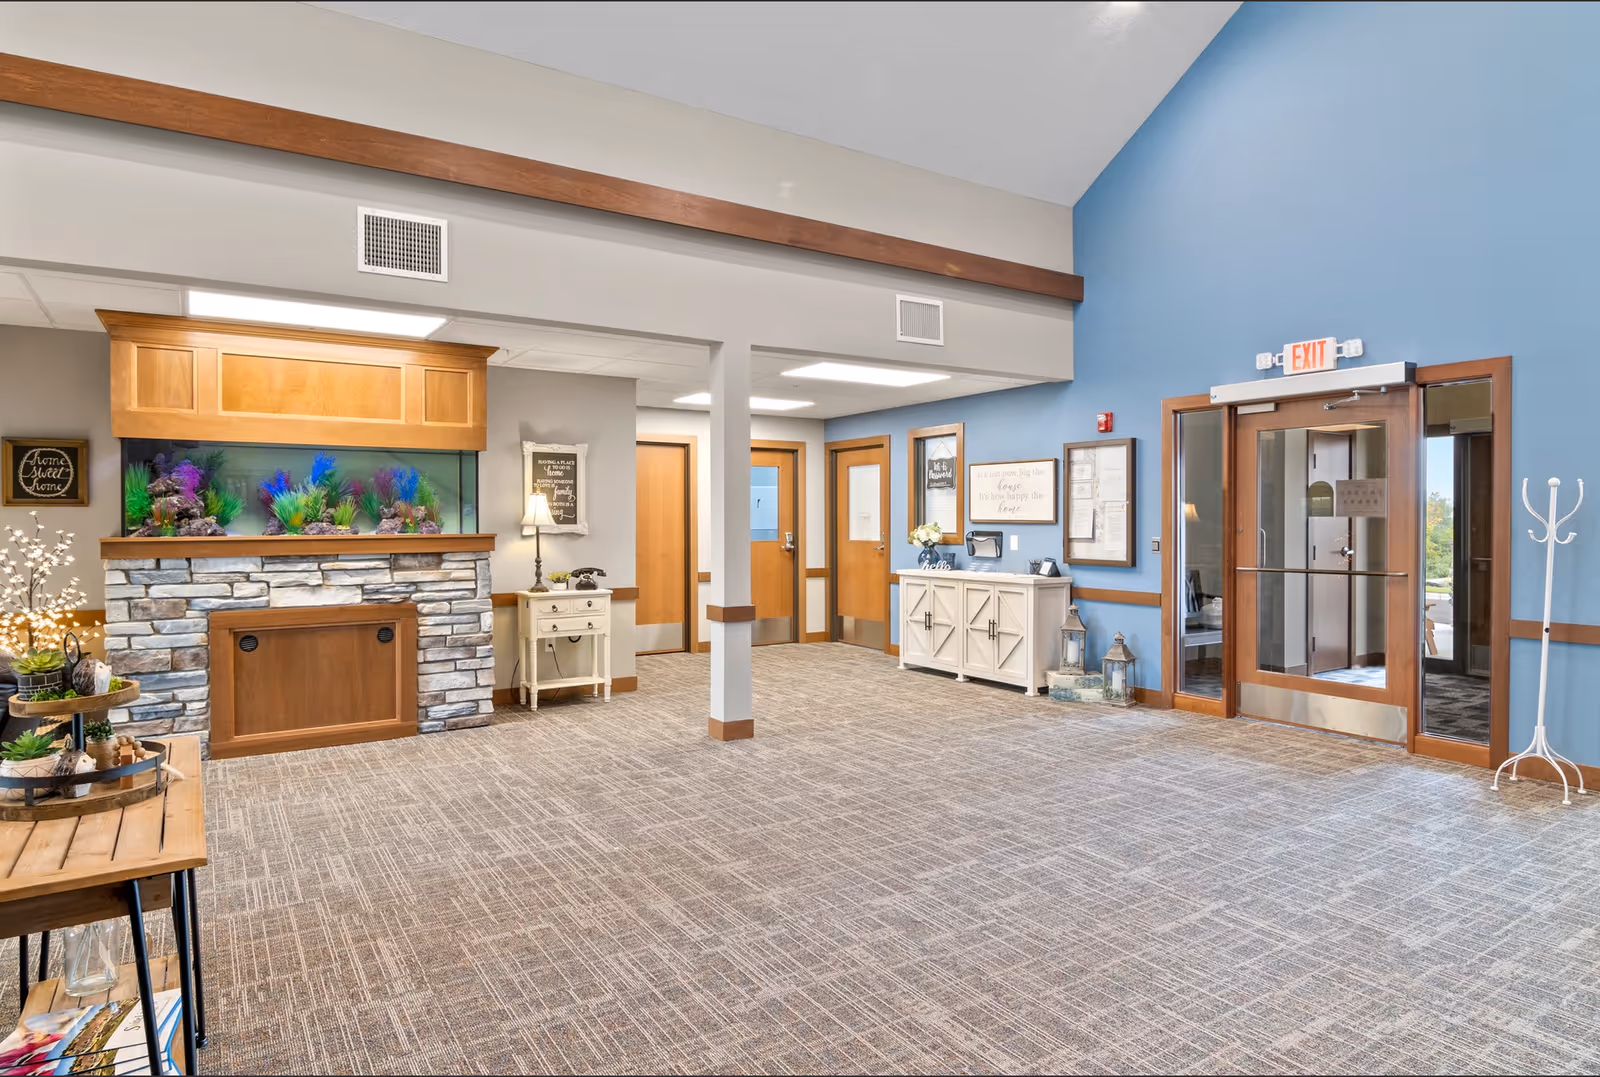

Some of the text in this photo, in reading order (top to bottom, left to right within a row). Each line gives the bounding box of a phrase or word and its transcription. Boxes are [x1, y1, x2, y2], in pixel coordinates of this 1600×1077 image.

[1292, 340, 1327, 371] EXIT
[29, 450, 66, 465] home
[29, 466, 70, 478] sweet
[543, 465, 564, 477] home
[27, 477, 62, 491] home
[553, 485, 576, 502] family
[1006, 491, 1029, 501] happy
[921, 559, 951, 571] hello
